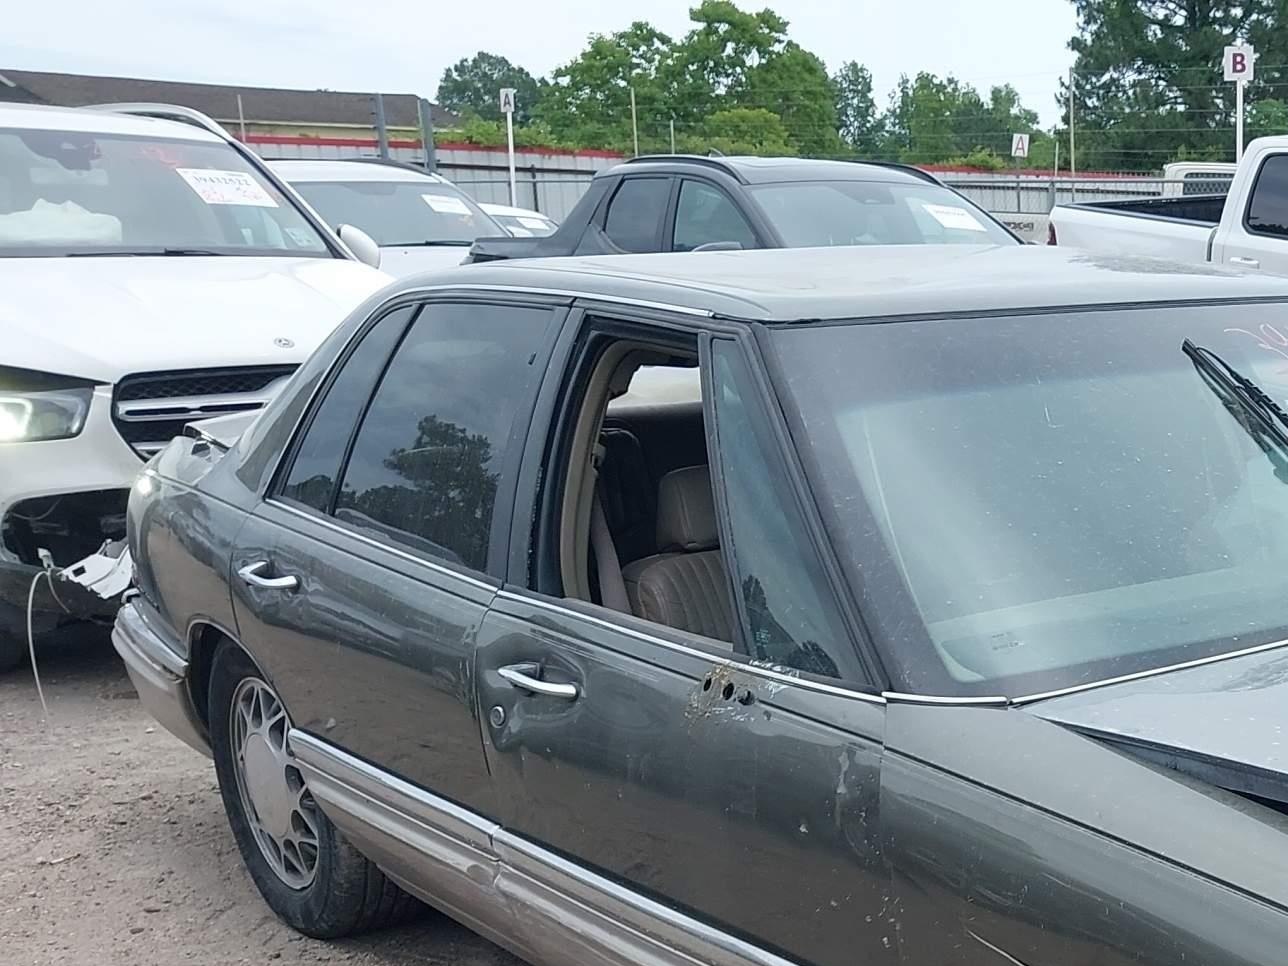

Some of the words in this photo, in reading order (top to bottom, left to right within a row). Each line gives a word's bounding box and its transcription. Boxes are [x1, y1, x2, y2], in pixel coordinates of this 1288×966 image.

[1232, 53, 1246, 73] B
[503, 93, 512, 107] A
[1014, 136, 1026, 155] A
